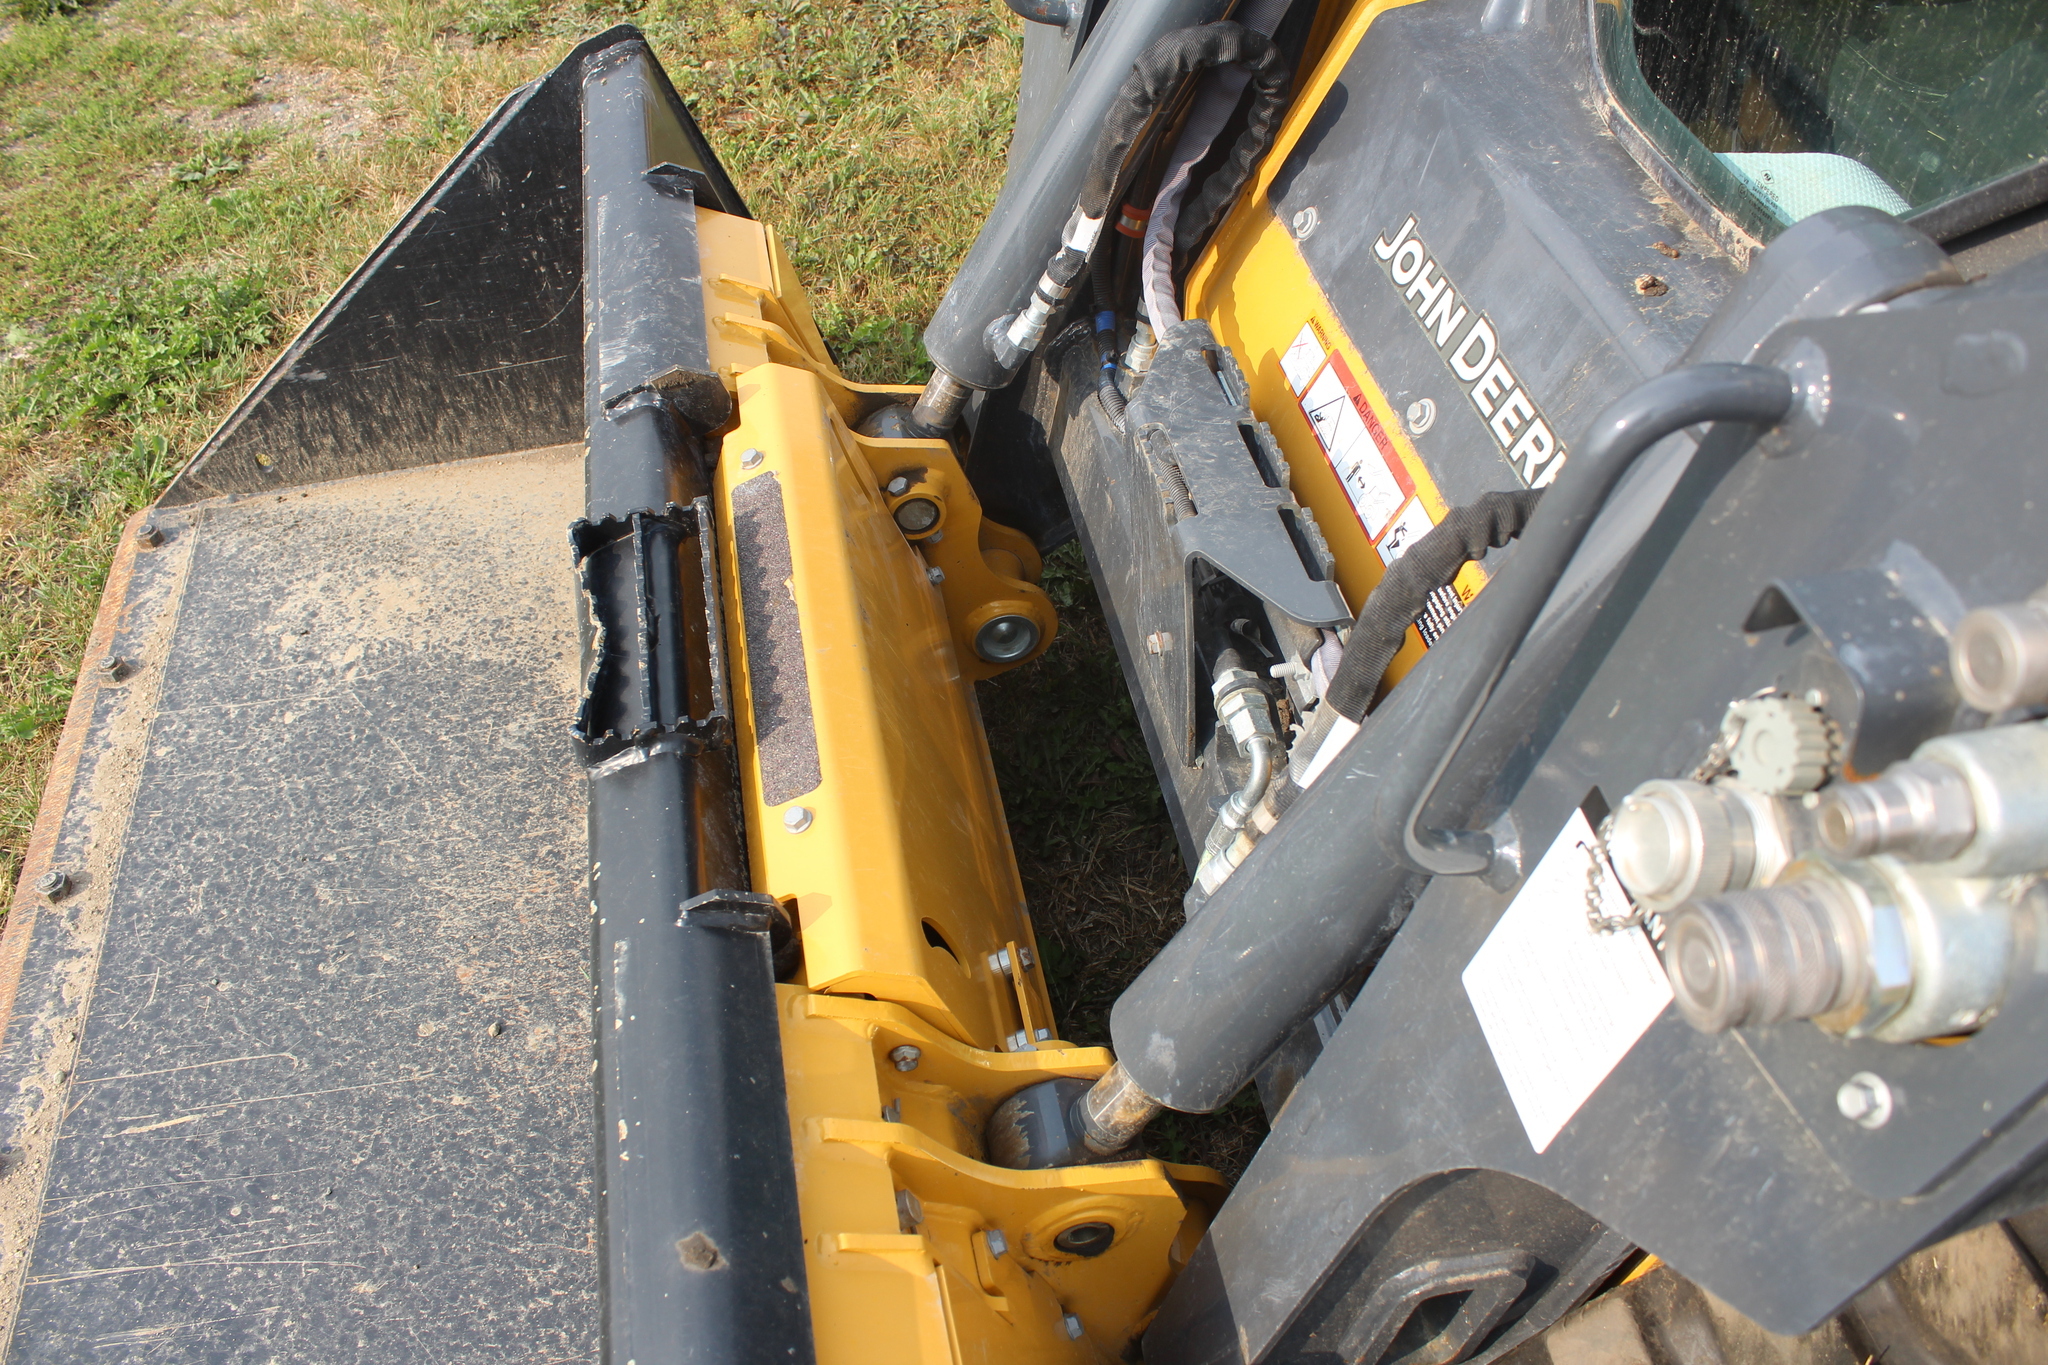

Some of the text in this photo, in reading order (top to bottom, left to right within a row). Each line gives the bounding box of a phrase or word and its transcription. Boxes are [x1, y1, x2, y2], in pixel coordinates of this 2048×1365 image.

[1373, 216, 1467, 348] JOHN
[1313, 319, 1332, 351] WARNING
[1359, 402, 1388, 451] DANGER
